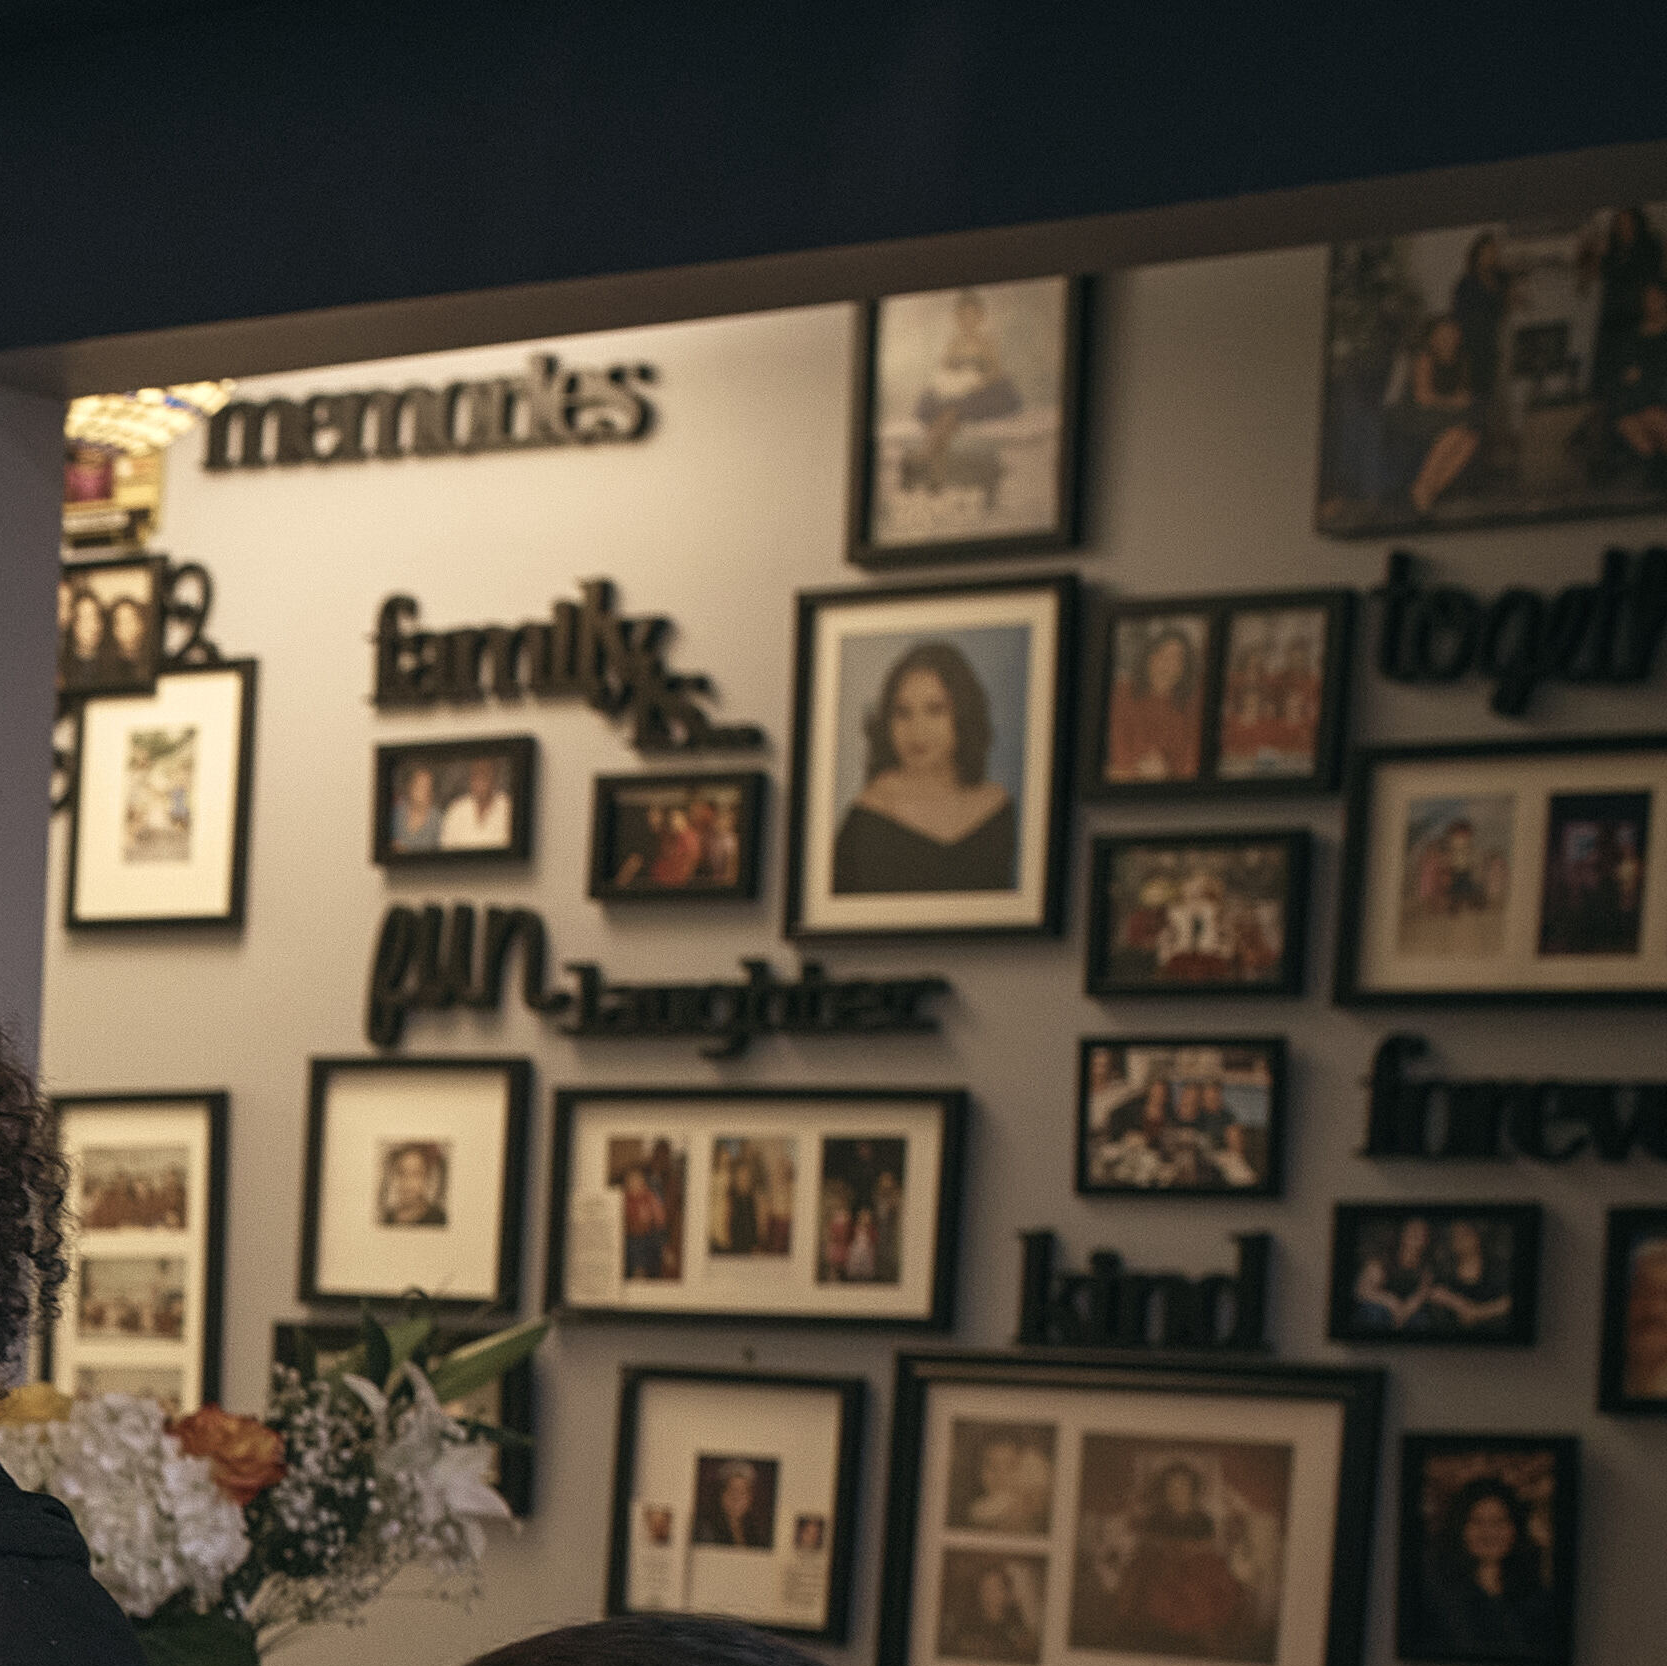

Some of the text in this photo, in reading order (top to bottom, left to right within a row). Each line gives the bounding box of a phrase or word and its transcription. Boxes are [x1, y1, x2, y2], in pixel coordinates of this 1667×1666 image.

[205, 352, 661, 473] memories
[369, 576, 742, 745] family
[367, 899, 565, 1048] fun
[560, 958, 950, 1060] laughter
[1016, 1229, 1273, 1352] kind
